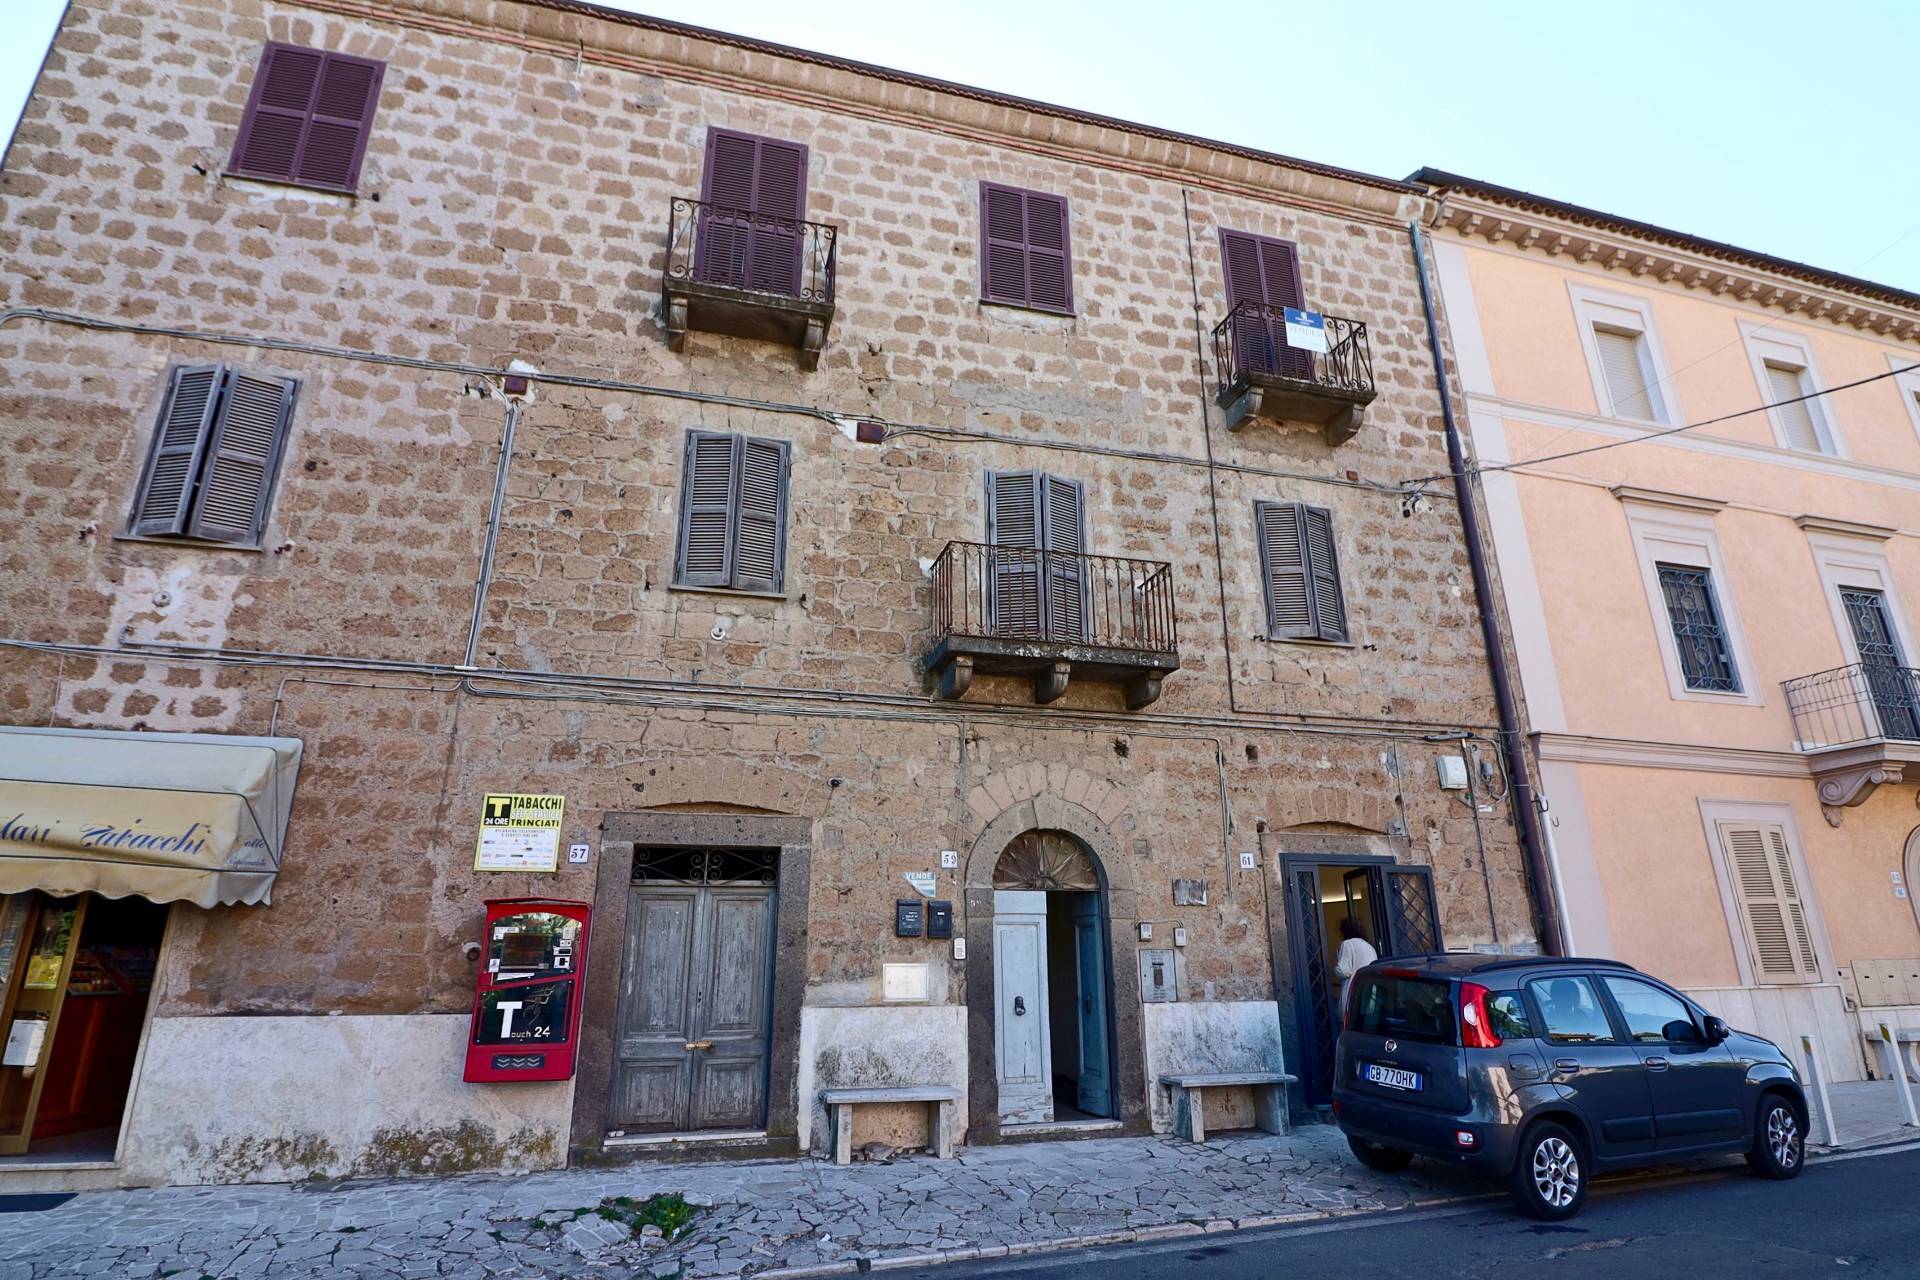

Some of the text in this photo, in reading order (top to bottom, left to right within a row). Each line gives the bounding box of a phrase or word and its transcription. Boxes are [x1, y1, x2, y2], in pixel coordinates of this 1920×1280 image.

[513, 797, 562, 809] TABACCHI
[485, 817, 509, 826] 24 ORE
[511, 818, 559, 827] TRINCIATI
[571, 848, 586, 859] 57
[943, 854, 957, 865] 59
[1242, 856, 1251, 865] 61
[534, 1026, 551, 1038] 24
[1370, 1066, 1381, 1080] GB
[1384, 1068, 1414, 1087] 770HK
